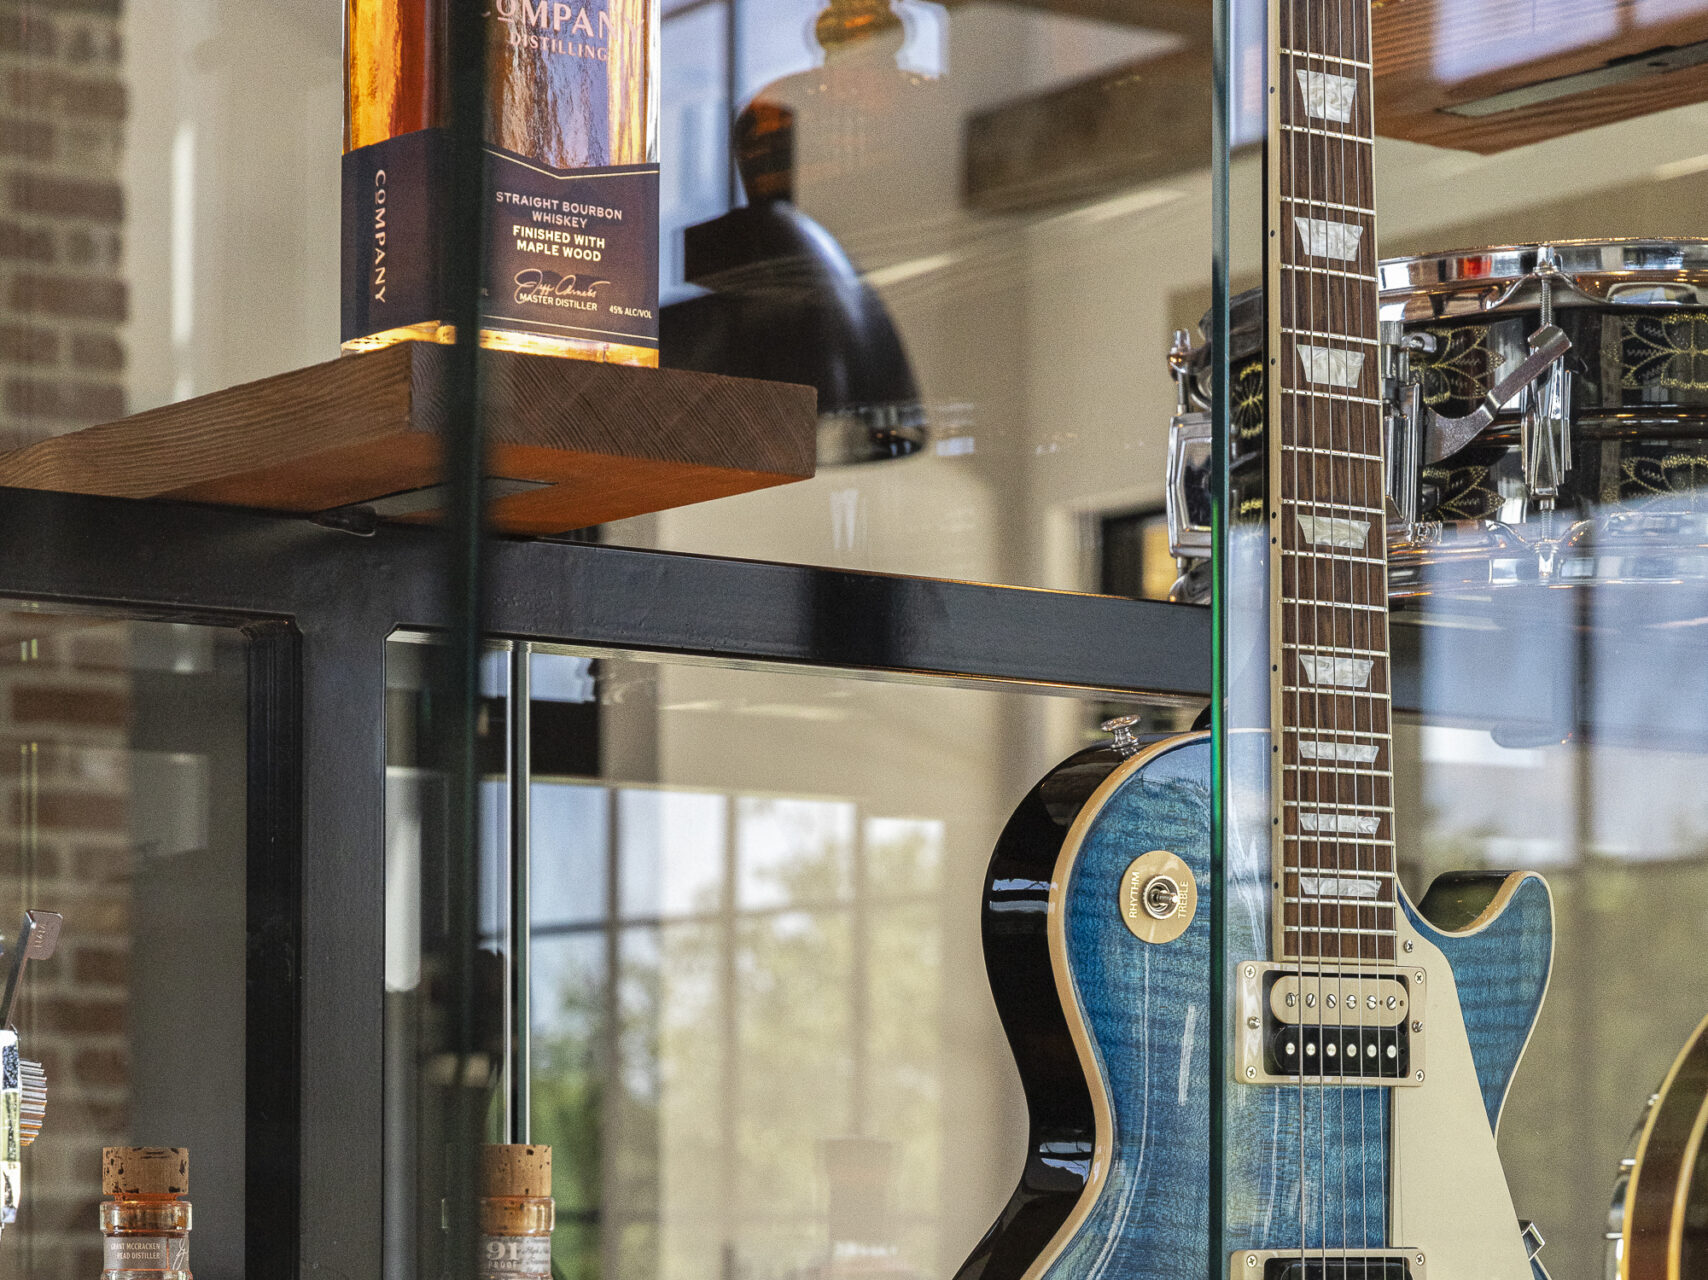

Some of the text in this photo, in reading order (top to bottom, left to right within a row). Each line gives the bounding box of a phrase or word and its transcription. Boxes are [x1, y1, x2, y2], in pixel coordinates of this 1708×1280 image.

[482, 0, 645, 45] OMPANY
[510, 31, 608, 62] DISTILLING
[496, 191, 623, 220] STRAIGHT BOURBON
[532, 211, 588, 229] WHISKEY
[374, 169, 387, 303] COMPANY
[512, 224, 606, 250] FINISHED WITH
[516, 239, 602, 262] MAPLE WOOD
[519, 292, 598, 312] MASTER DISTILLER
[608, 304, 623, 316] 45%
[1128, 871, 1140, 919] RHYTHM
[1177, 880, 1189, 919] TREBLE
[486, 1241, 519, 1261] 91
